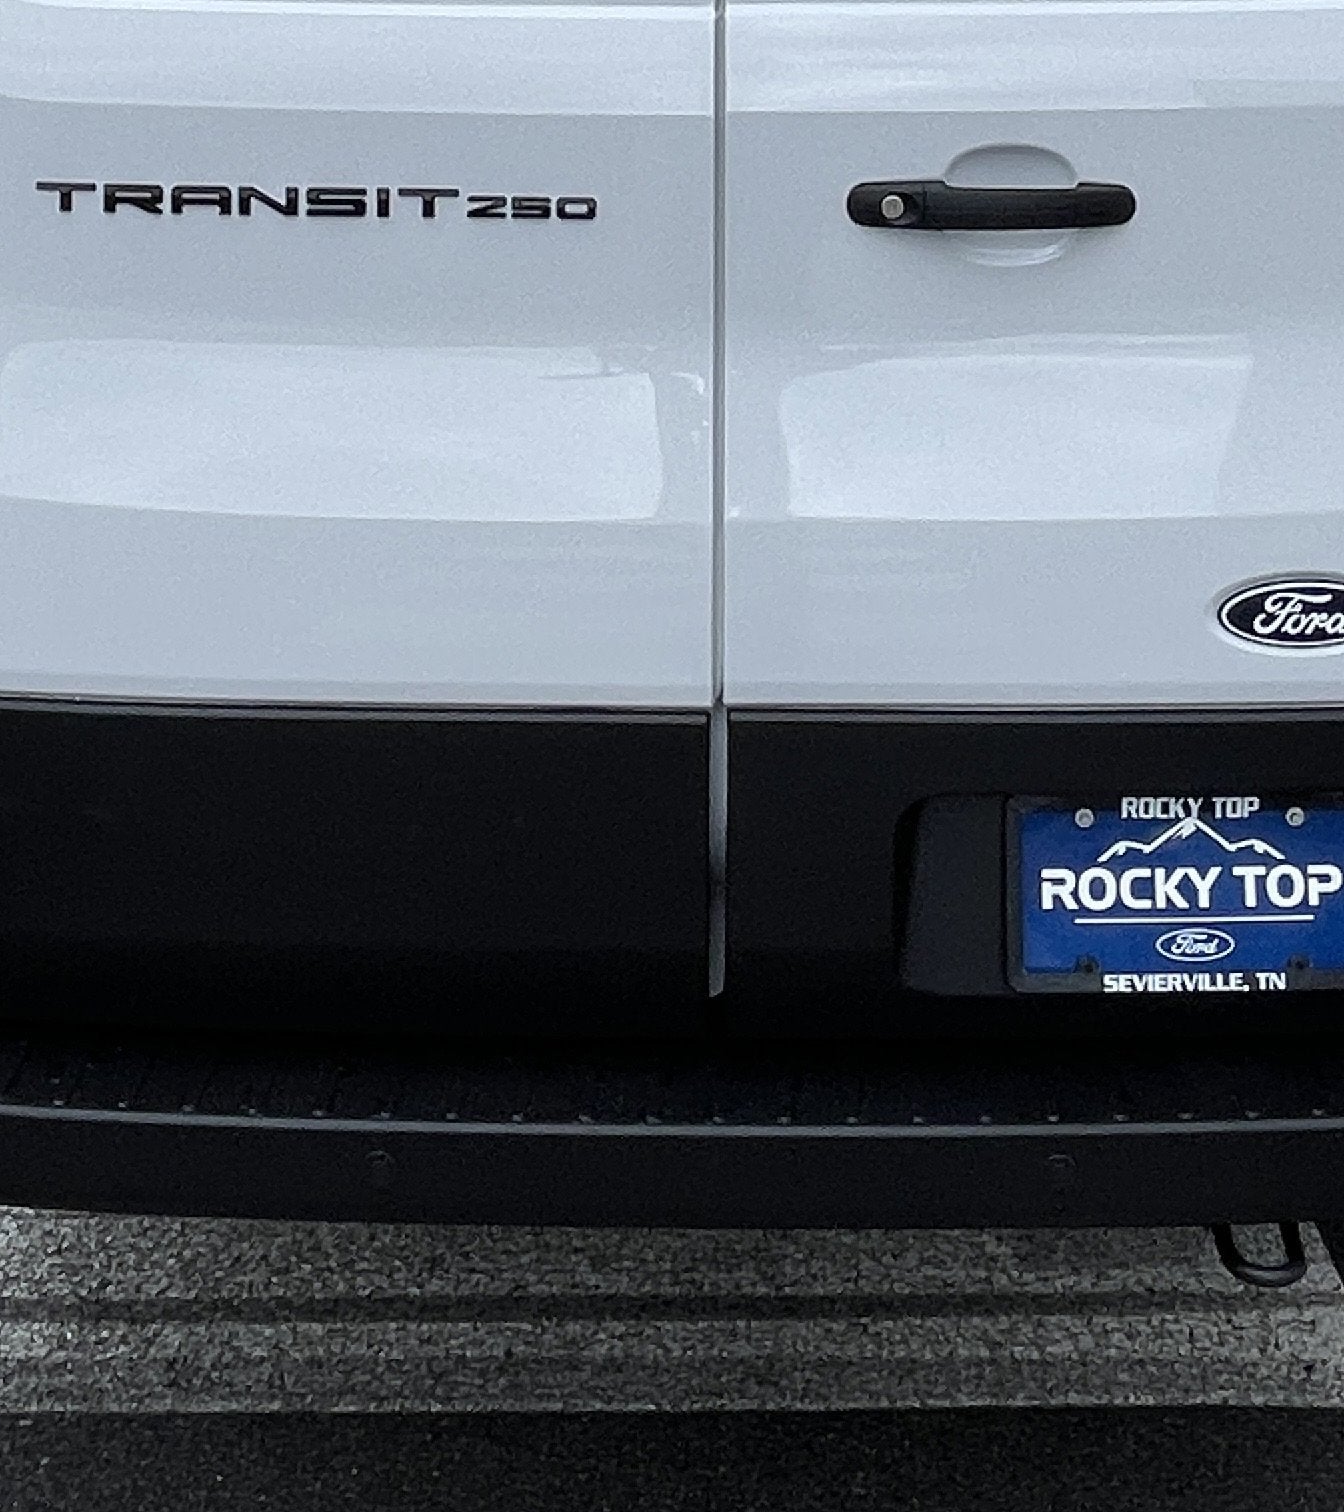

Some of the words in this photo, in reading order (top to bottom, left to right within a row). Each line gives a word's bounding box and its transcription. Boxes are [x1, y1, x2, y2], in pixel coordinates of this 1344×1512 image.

[36, 181, 459, 218] TRANSIT
[466, 195, 597, 220] 250
[1121, 797, 1203, 819] ROCKY
[1212, 797, 1260, 819] TOP
[1040, 866, 1222, 910] ROCKY
[1232, 864, 1344, 908] TOP
[1170, 934, 1220, 956] Ford
[1103, 973, 1250, 993] SEVIERVILLE,
[1255, 972, 1287, 990] TN
